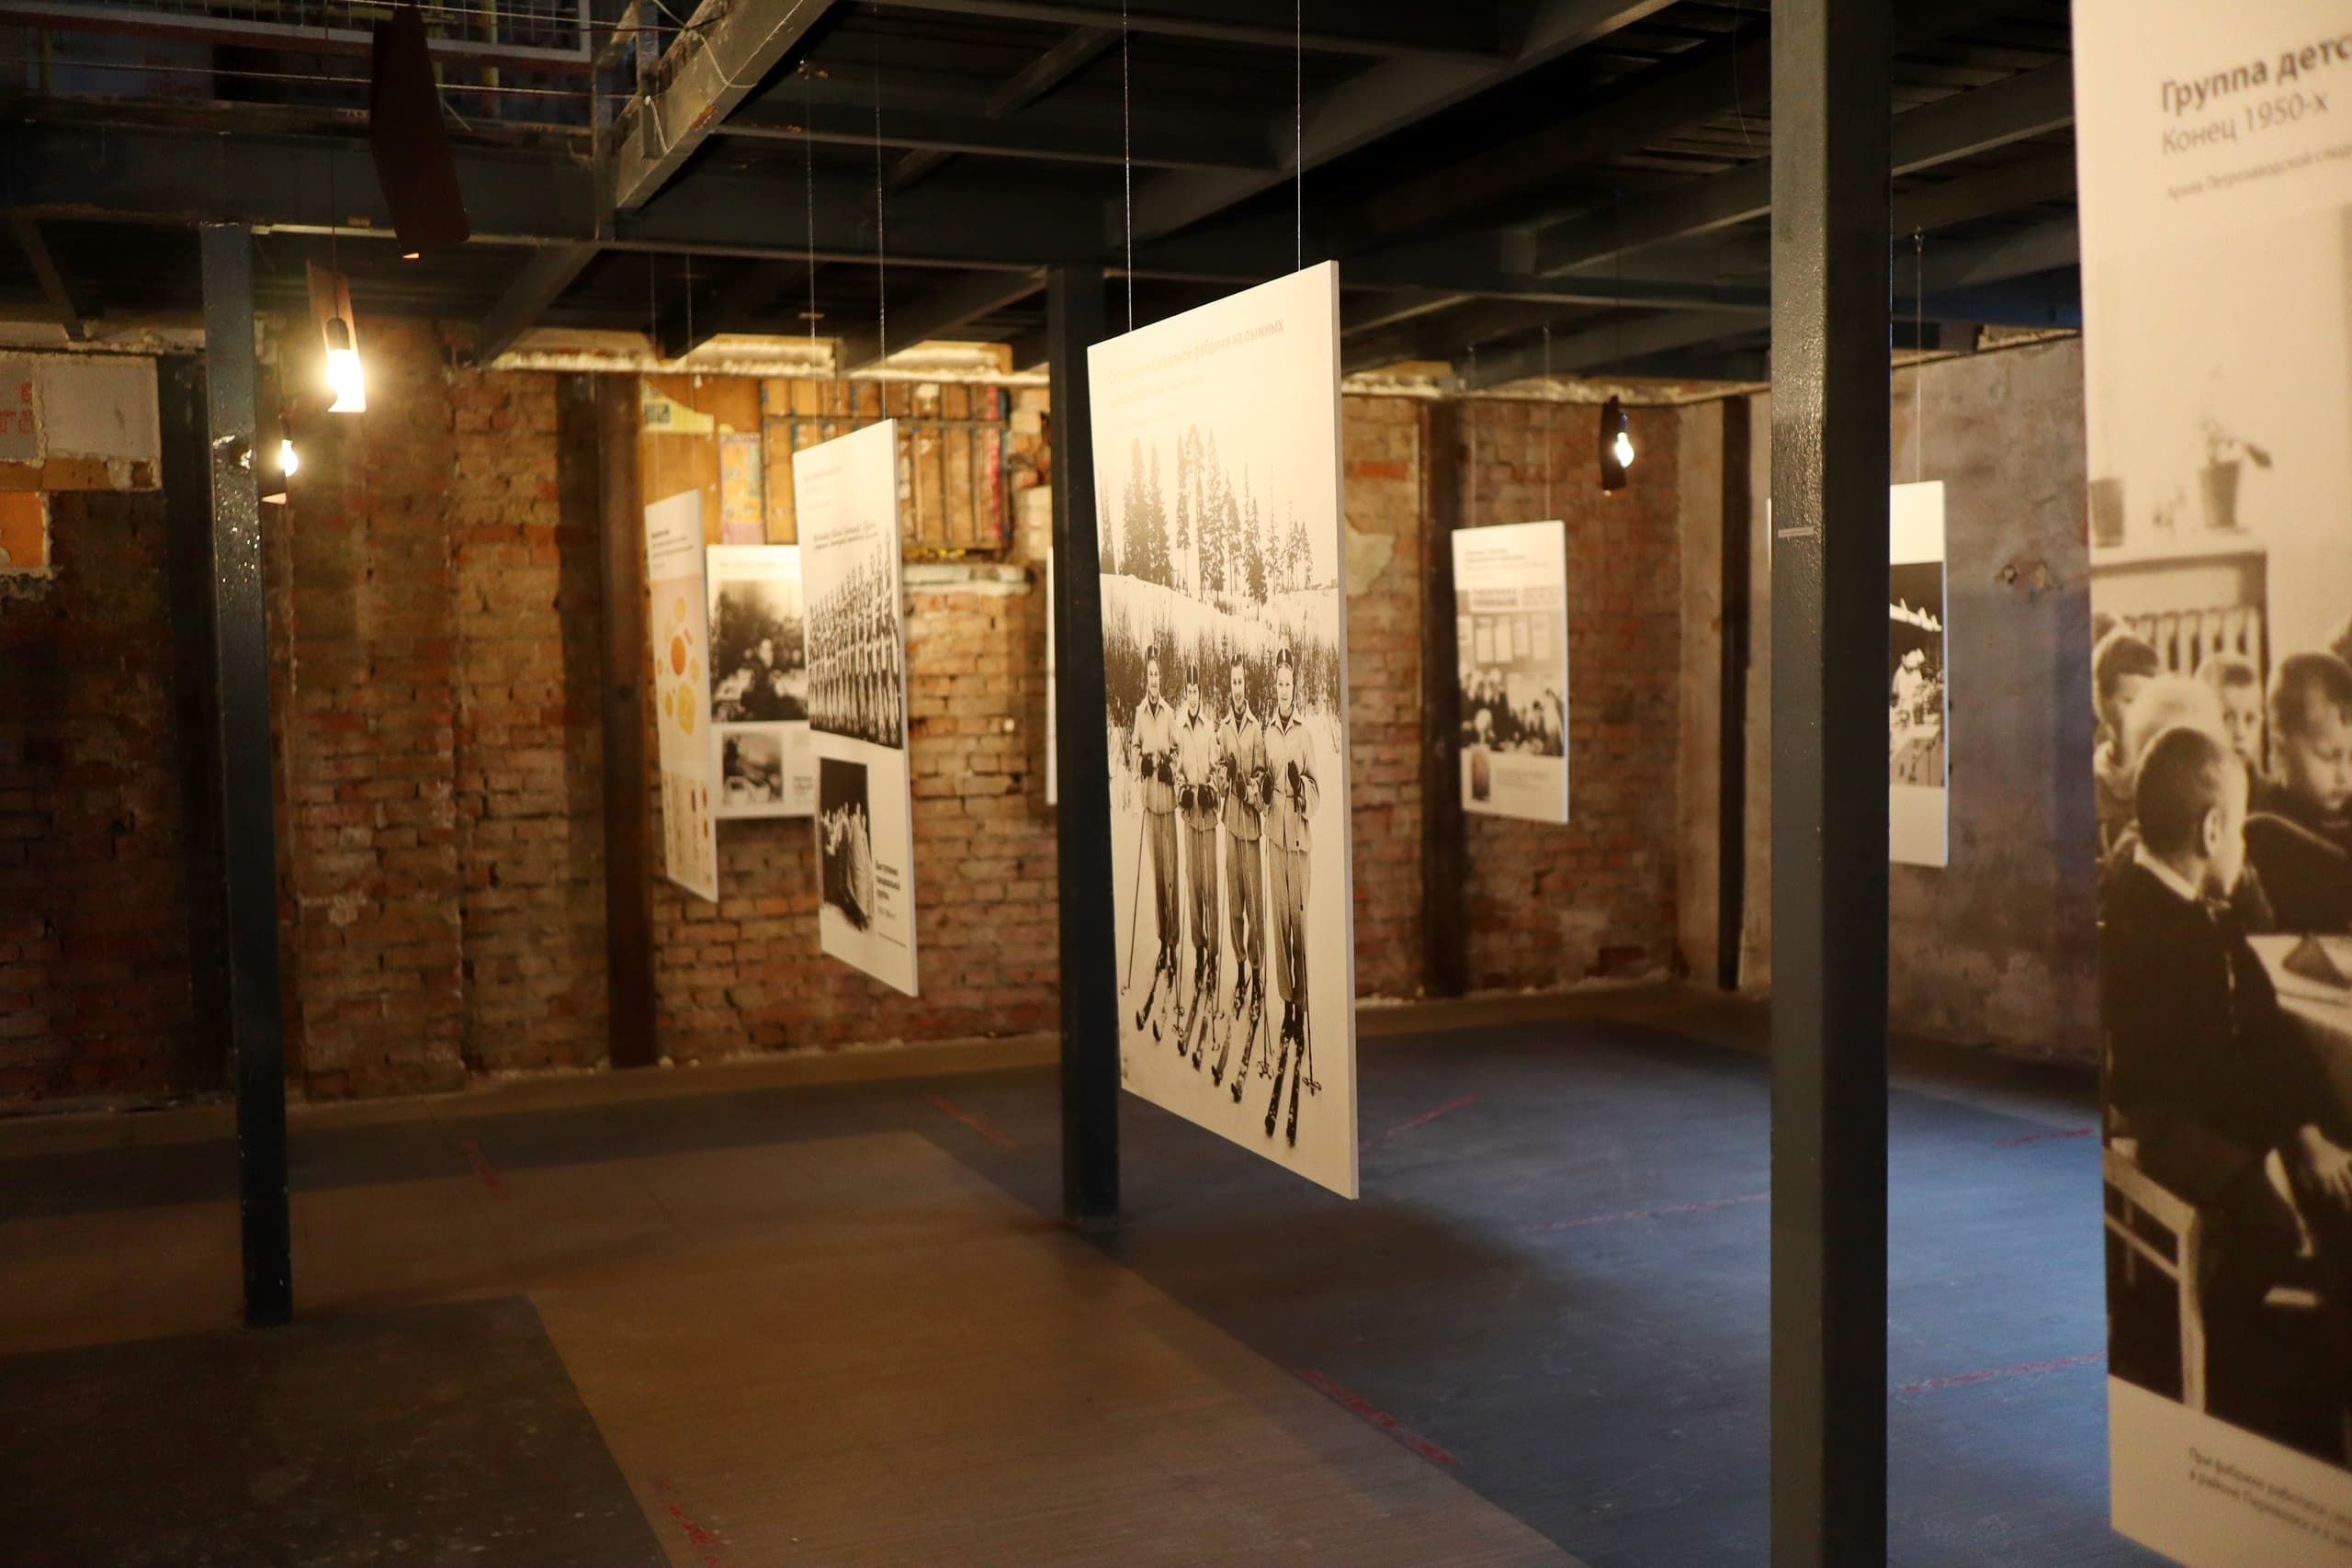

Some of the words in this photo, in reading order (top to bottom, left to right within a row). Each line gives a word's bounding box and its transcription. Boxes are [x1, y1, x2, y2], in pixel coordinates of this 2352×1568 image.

[2161, 59, 2268, 118] Группа
[2161, 118, 2239, 156] Конец
[2245, 92, 2329, 131] 1950-х
